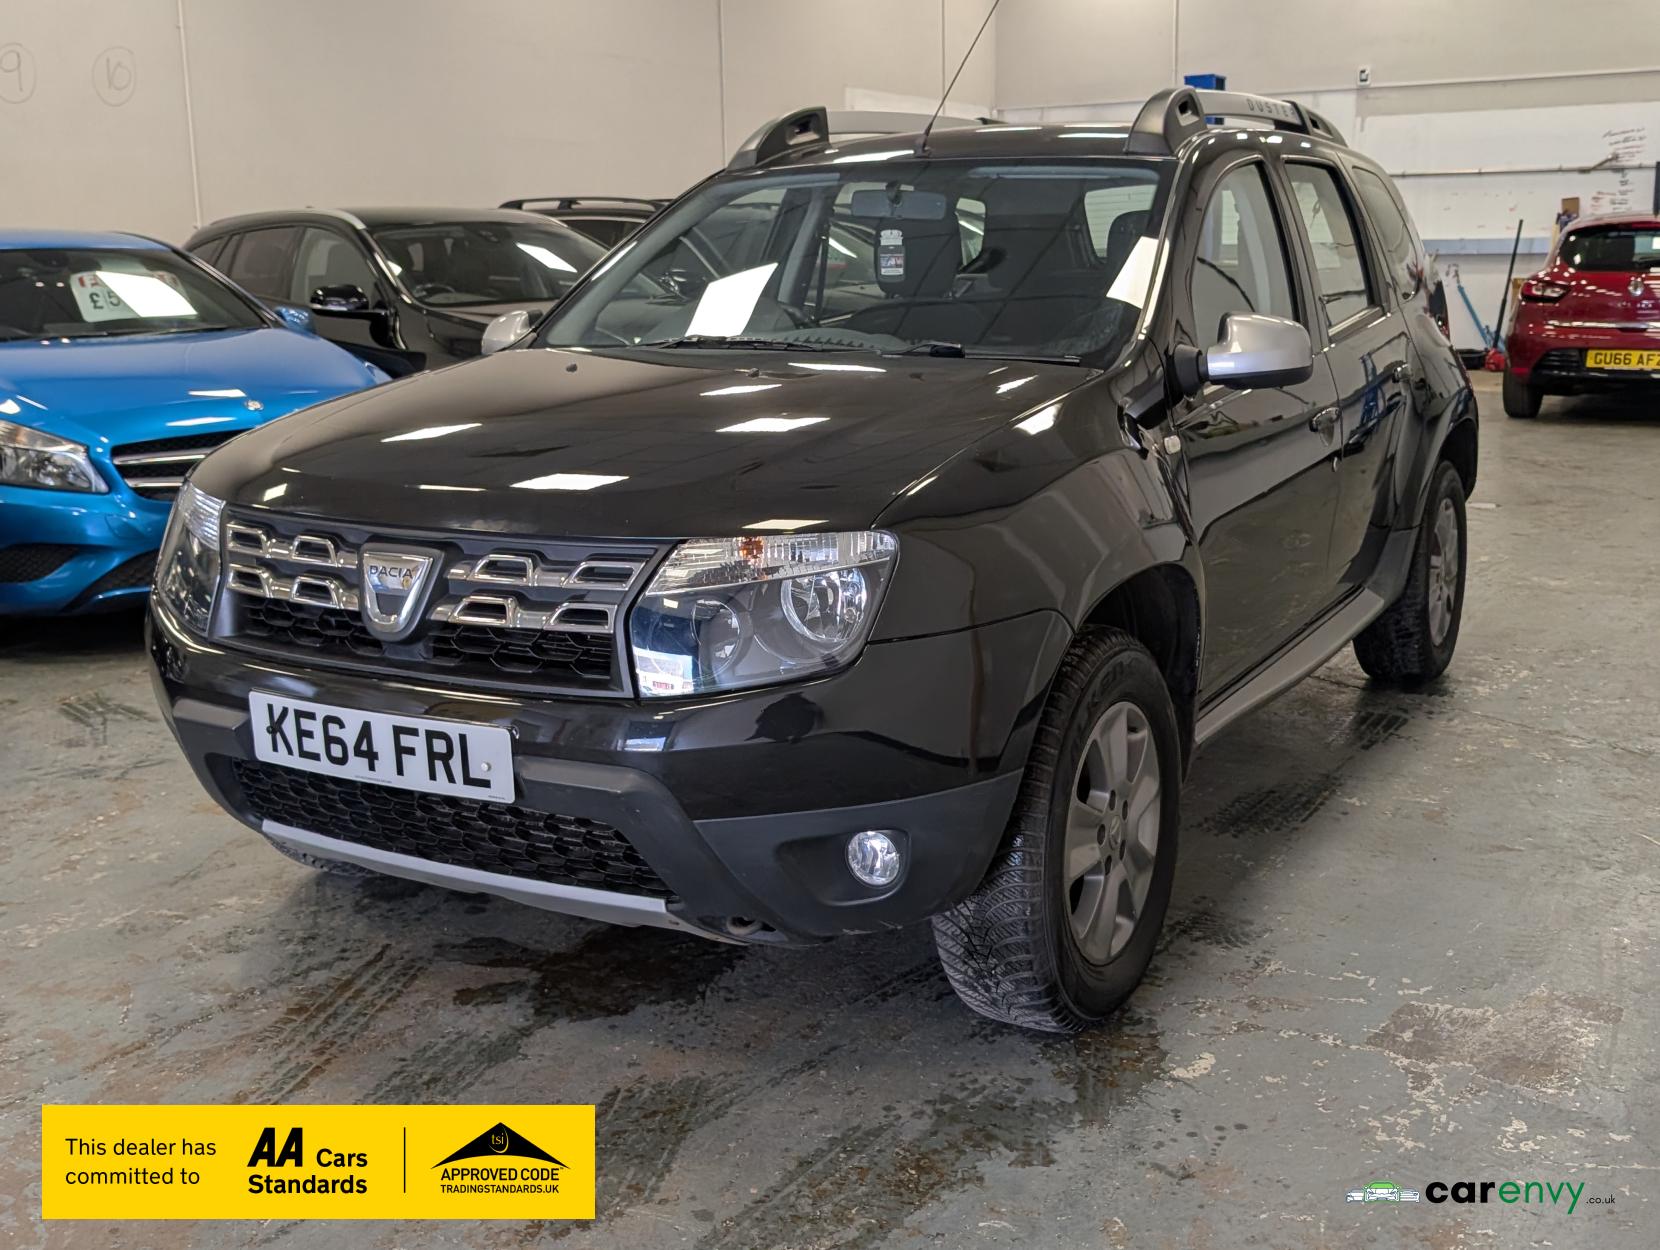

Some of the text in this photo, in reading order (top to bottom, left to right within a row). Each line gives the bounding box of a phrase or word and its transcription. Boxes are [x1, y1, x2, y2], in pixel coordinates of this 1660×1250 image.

[1593, 352, 1633, 366] GU66
[369, 565, 413, 579] DACIA
[267, 703, 493, 790] KE64 FRL
